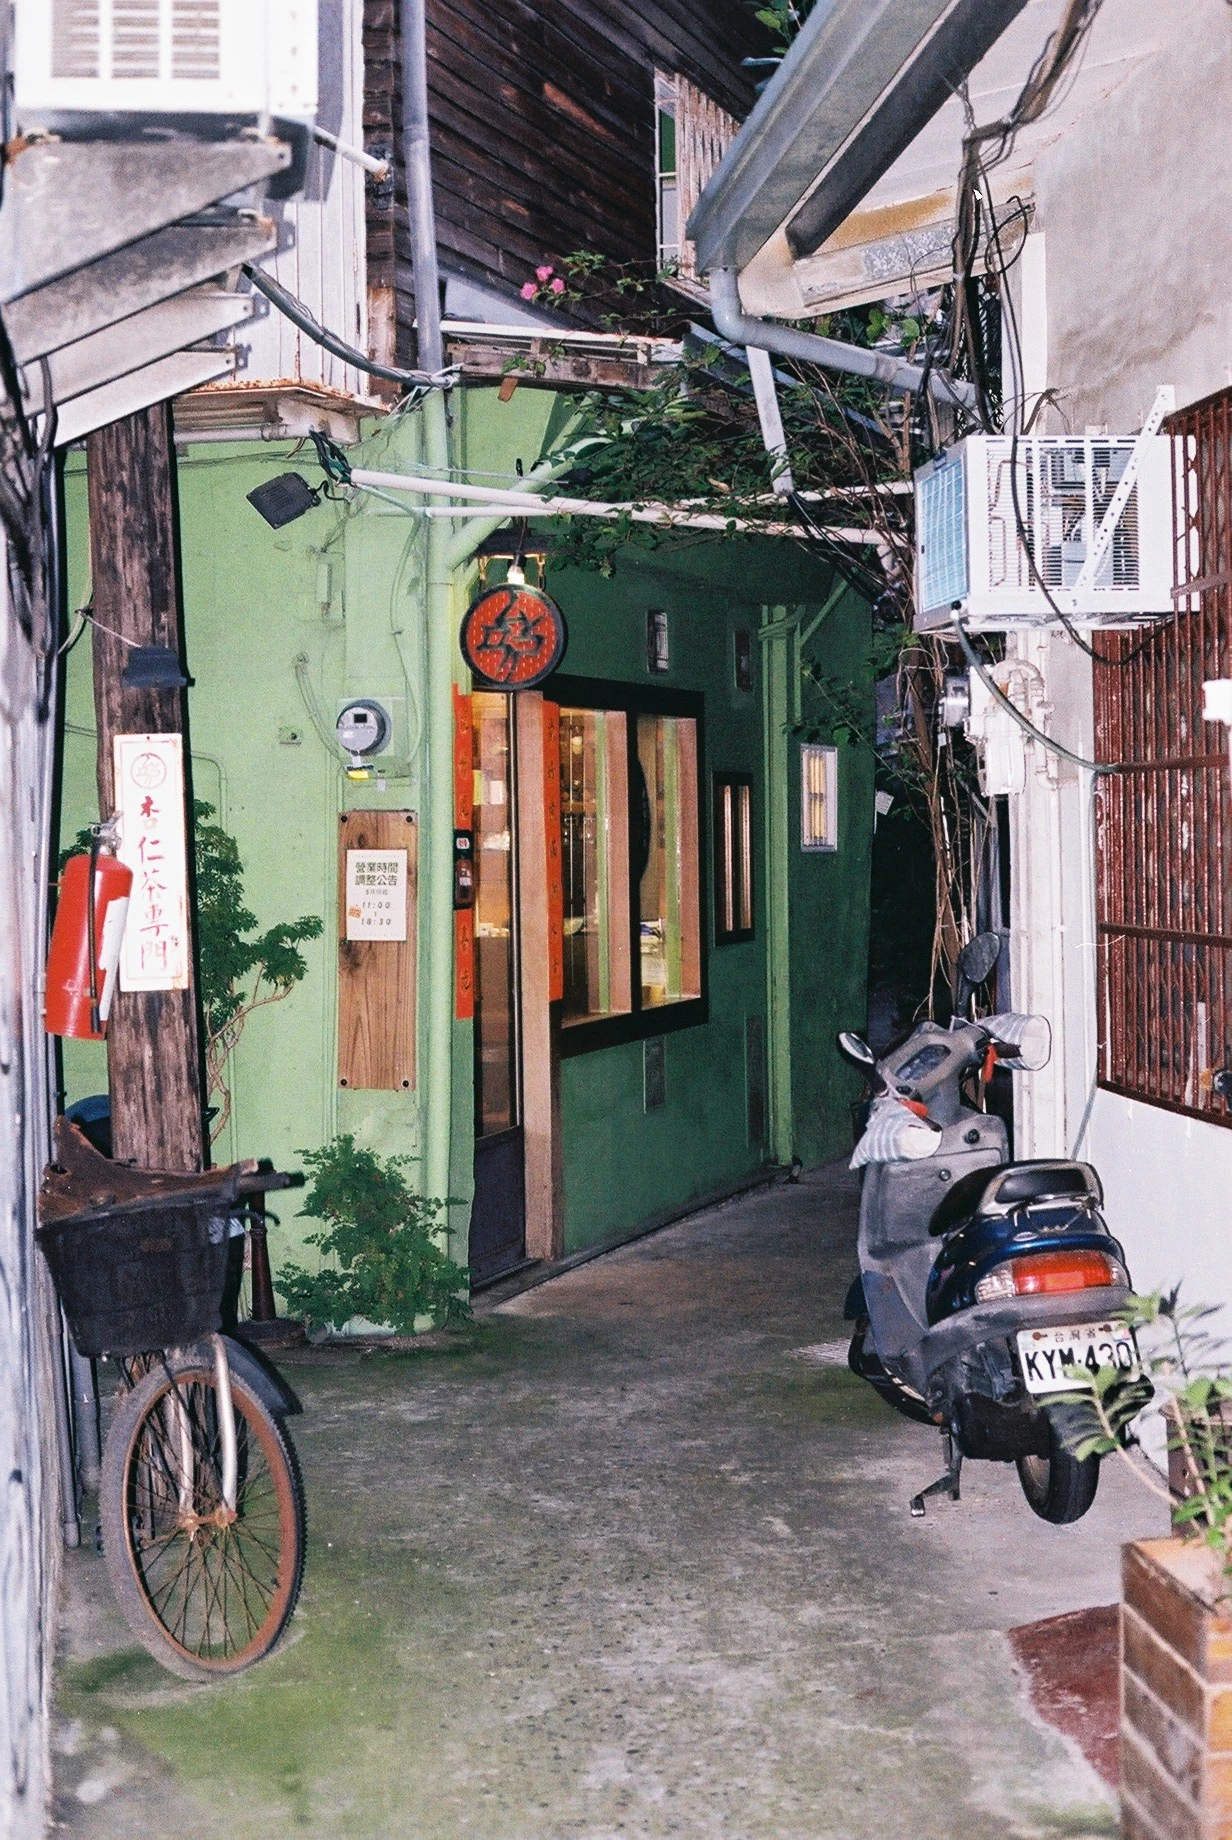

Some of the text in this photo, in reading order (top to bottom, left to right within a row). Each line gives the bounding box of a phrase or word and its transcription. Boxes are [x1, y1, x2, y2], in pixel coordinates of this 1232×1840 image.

[355, 862, 398, 873] 營業時間
[138, 795, 169, 971] 杏仁茶專門
[355, 875, 398, 886] 調整公告
[362, 901, 391, 909] 11:00
